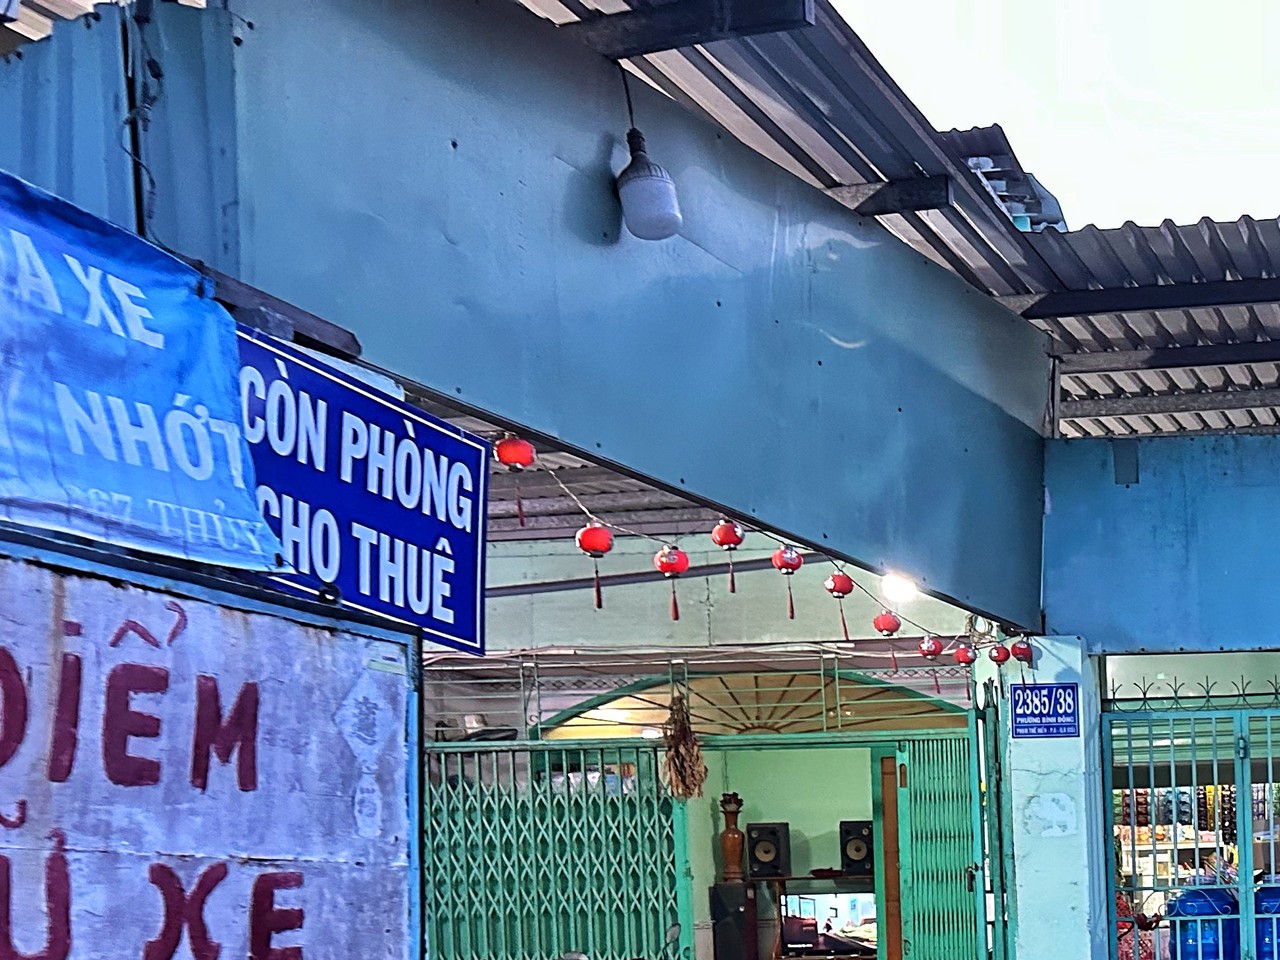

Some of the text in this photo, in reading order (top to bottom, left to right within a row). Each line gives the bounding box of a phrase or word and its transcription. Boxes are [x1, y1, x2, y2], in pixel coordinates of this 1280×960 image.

[64, 253, 165, 348] XE
[54, 381, 247, 488] NHỚT
[239, 359, 473, 533] CÒN PHÒNG
[351, 521, 456, 624] THUÊ
[1015, 688, 1074, 715] 2385/38
